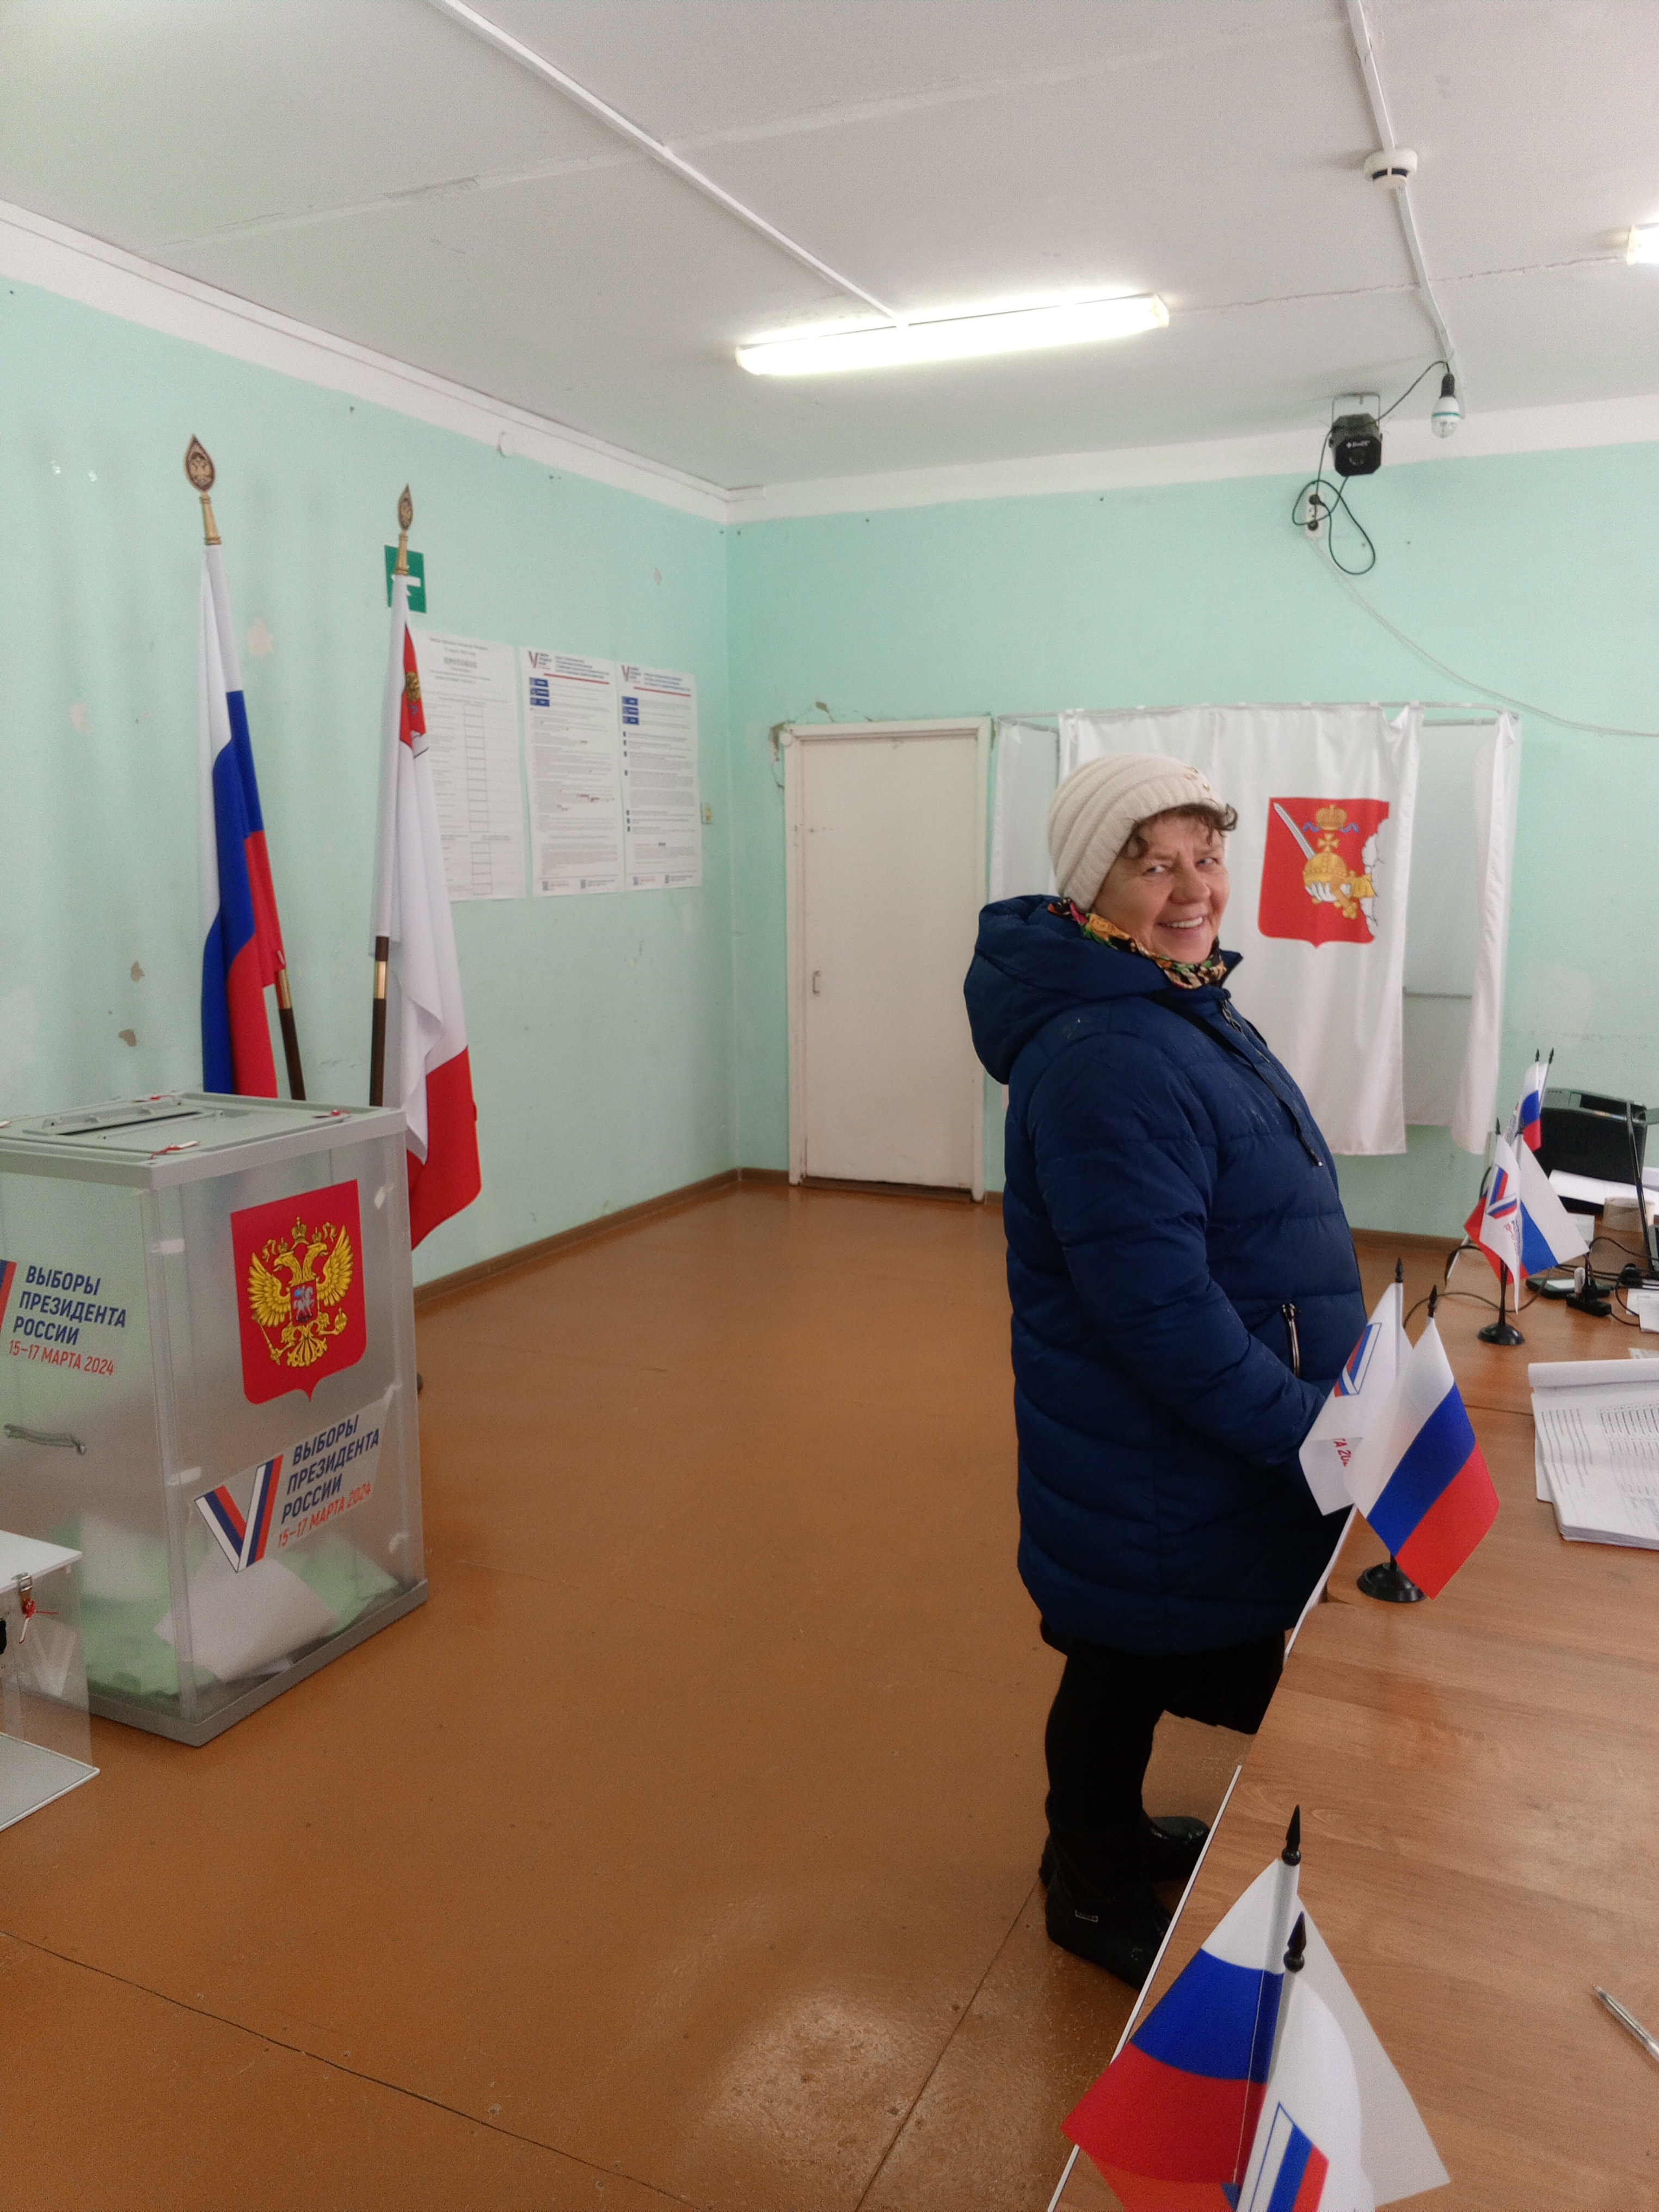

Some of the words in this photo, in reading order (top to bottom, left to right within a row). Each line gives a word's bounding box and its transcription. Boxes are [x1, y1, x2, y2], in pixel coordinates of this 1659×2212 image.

[26, 1265, 101, 1295] ВЫБОРЫ
[13, 1316, 79, 1345] РОССИИ
[19, 1291, 126, 1328] ПРЕЗИДЕНТА
[41, 1347, 81, 1369] МАРТА
[84, 1356, 114, 1375] 2024
[292, 1415, 359, 1466] ВЫБОРЫ
[287, 1428, 379, 1496] ПРЕЗИДЕНТА
[281, 1473, 342, 1524] РОССИИ
[310, 1496, 345, 1530] МАРТА
[347, 1482, 371, 1508] 2024
